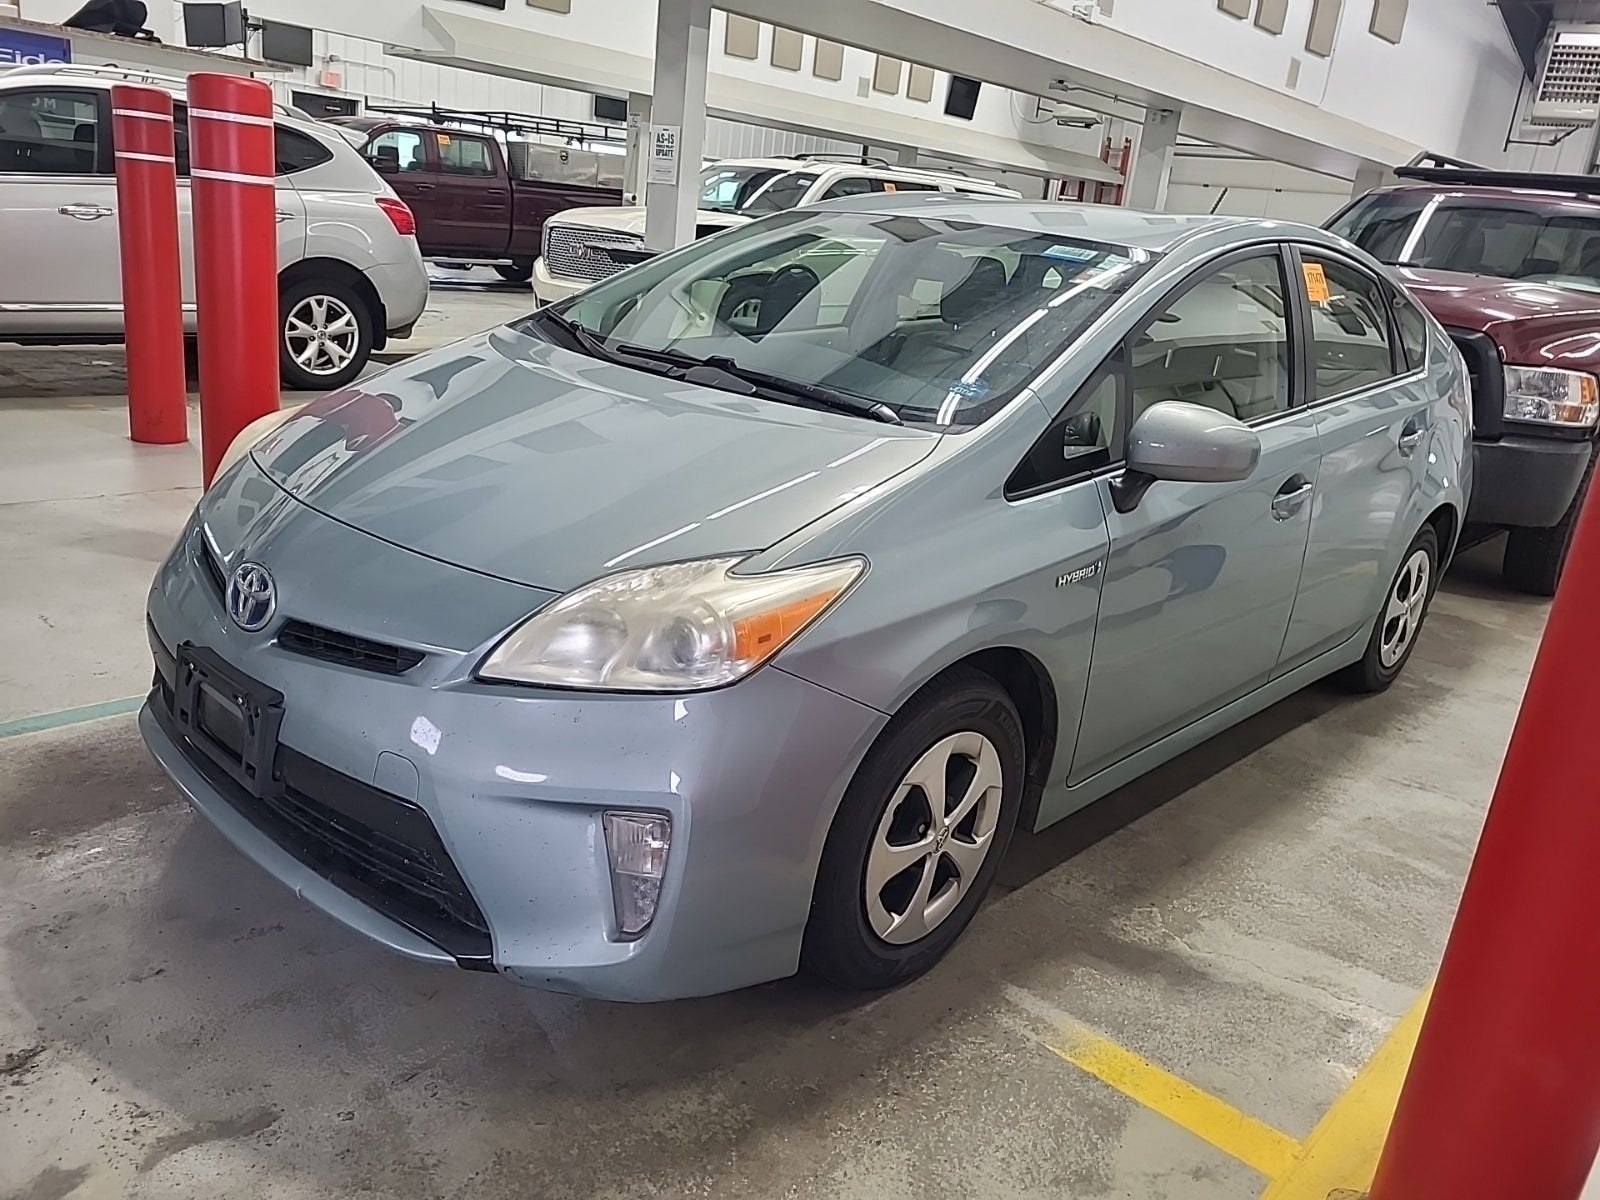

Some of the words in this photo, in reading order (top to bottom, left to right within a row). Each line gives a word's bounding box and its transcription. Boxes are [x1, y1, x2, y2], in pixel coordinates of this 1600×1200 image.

[656, 132, 675, 145] AS-IS
[569, 243, 600, 261] GMC
[1056, 563, 1096, 587] HYBRID
